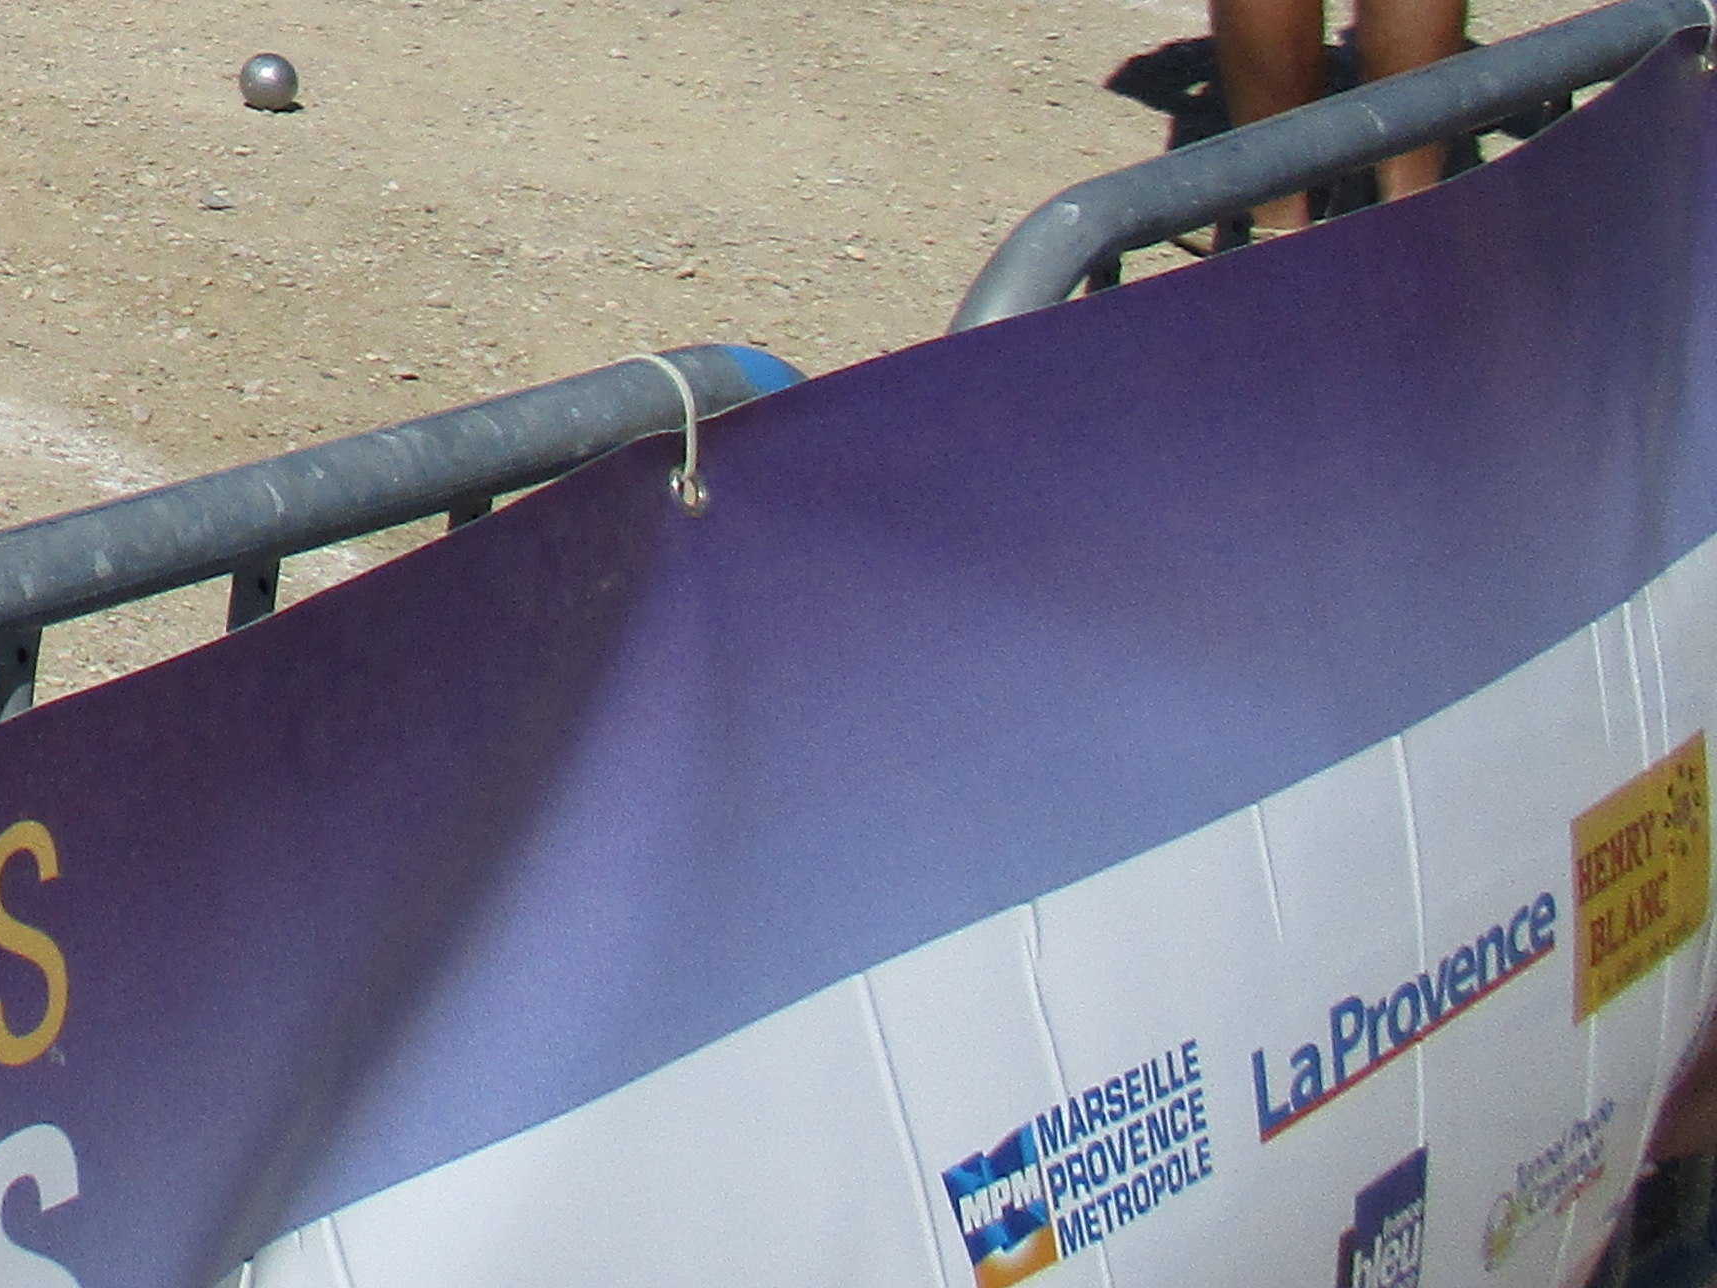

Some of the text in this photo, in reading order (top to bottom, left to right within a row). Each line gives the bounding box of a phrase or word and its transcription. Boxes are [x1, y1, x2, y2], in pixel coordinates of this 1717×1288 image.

[1575, 809, 1655, 907] HENRY
[1590, 870, 1669, 967] BLANC
[1251, 1042, 1324, 1134] La
[1330, 891, 1557, 1085] Provence
[1034, 1037, 1203, 1159] MARSEILLE
[1046, 1086, 1209, 1211] PROVENCE
[958, 1163, 1045, 1236] MPM
[1056, 1135, 1214, 1260] METROPOLE
